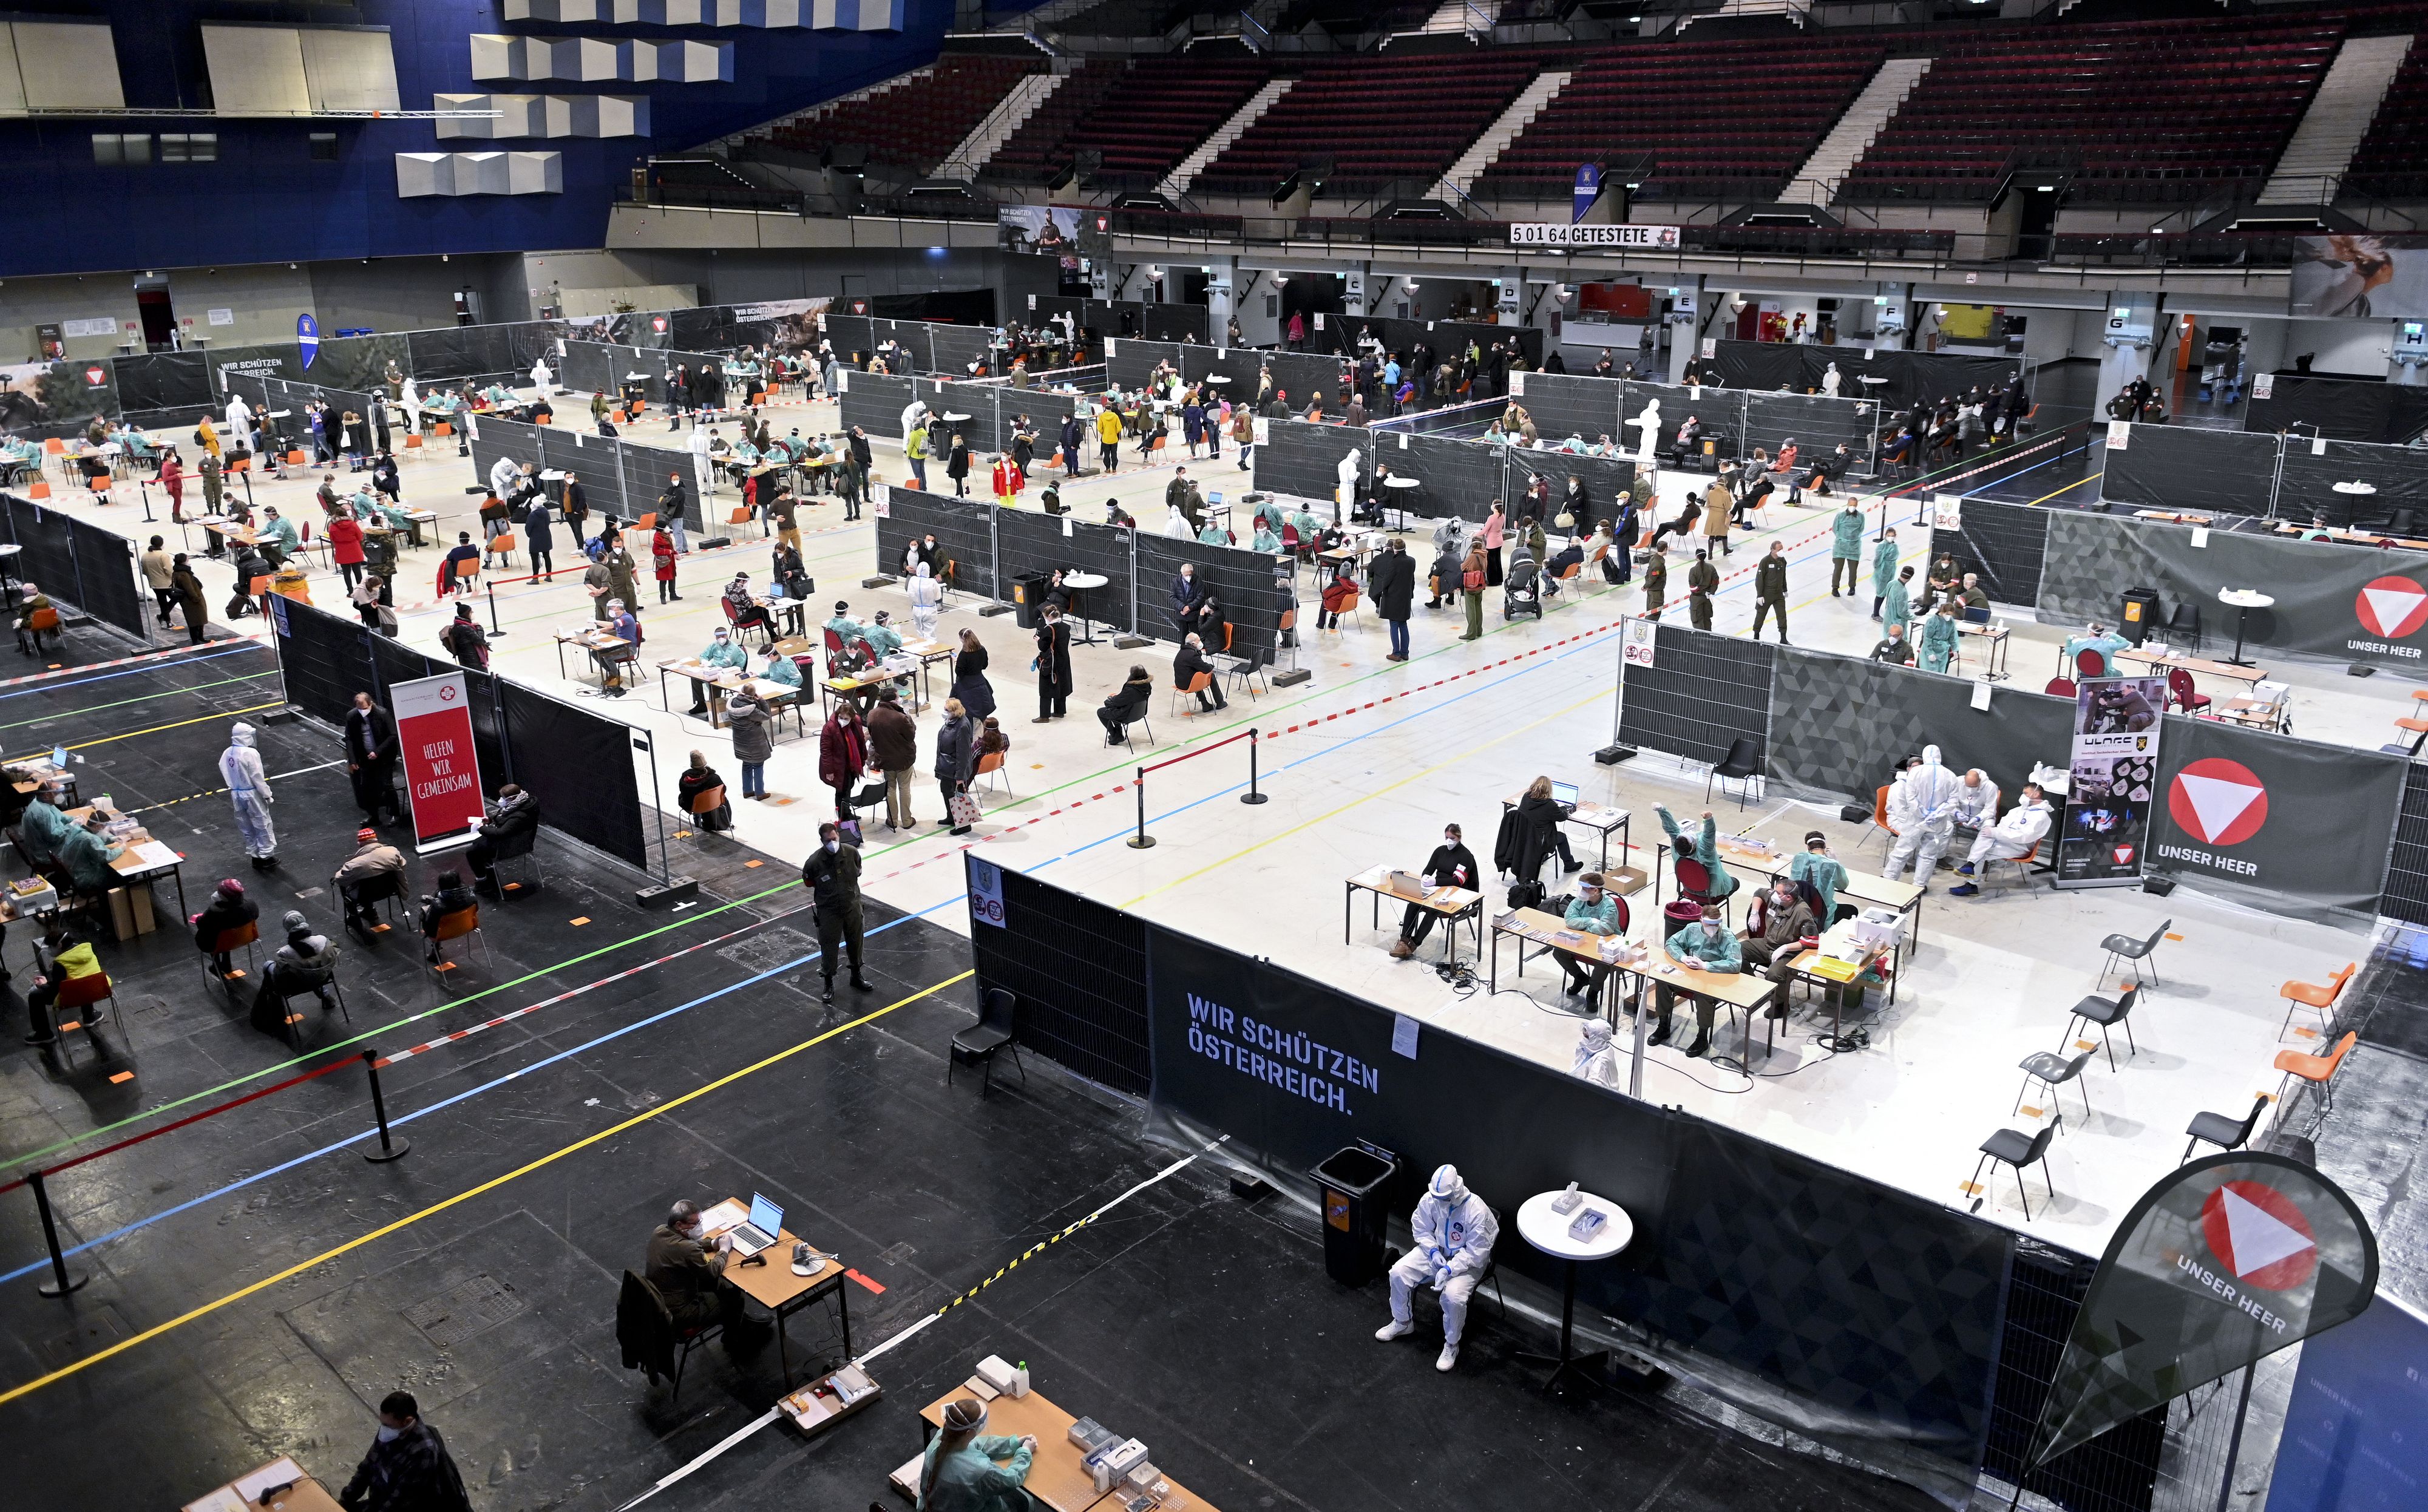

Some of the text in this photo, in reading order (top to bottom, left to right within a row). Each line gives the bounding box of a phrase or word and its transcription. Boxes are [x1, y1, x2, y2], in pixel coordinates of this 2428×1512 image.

[1572, 228, 1649, 243] GETESTETE
[1681, 297, 1689, 306] E
[736, 314, 771, 323] ÖSTERREICH.
[747, 306, 775, 315] SCHÜTZEN
[1887, 308, 1895, 316] F
[2110, 318, 2123, 328] G
[2407, 333, 2423, 345] H
[221, 358, 282, 370] WIR SCHÜTZEN
[2347, 640, 2422, 659] UNSER HEER
[422, 739, 454, 759] HELFEN
[432, 759, 452, 776] WIR
[417, 772, 472, 799] GEMEINSAM
[2158, 844, 2257, 876] UNSER HEER
[1187, 992, 1233, 1034] WIR
[1242, 1017, 1378, 1094] SCHÜTZEN
[1188, 1021, 1352, 1116] ÖSTERREICH.
[2177, 1255, 2287, 1334] UNSER HEER
